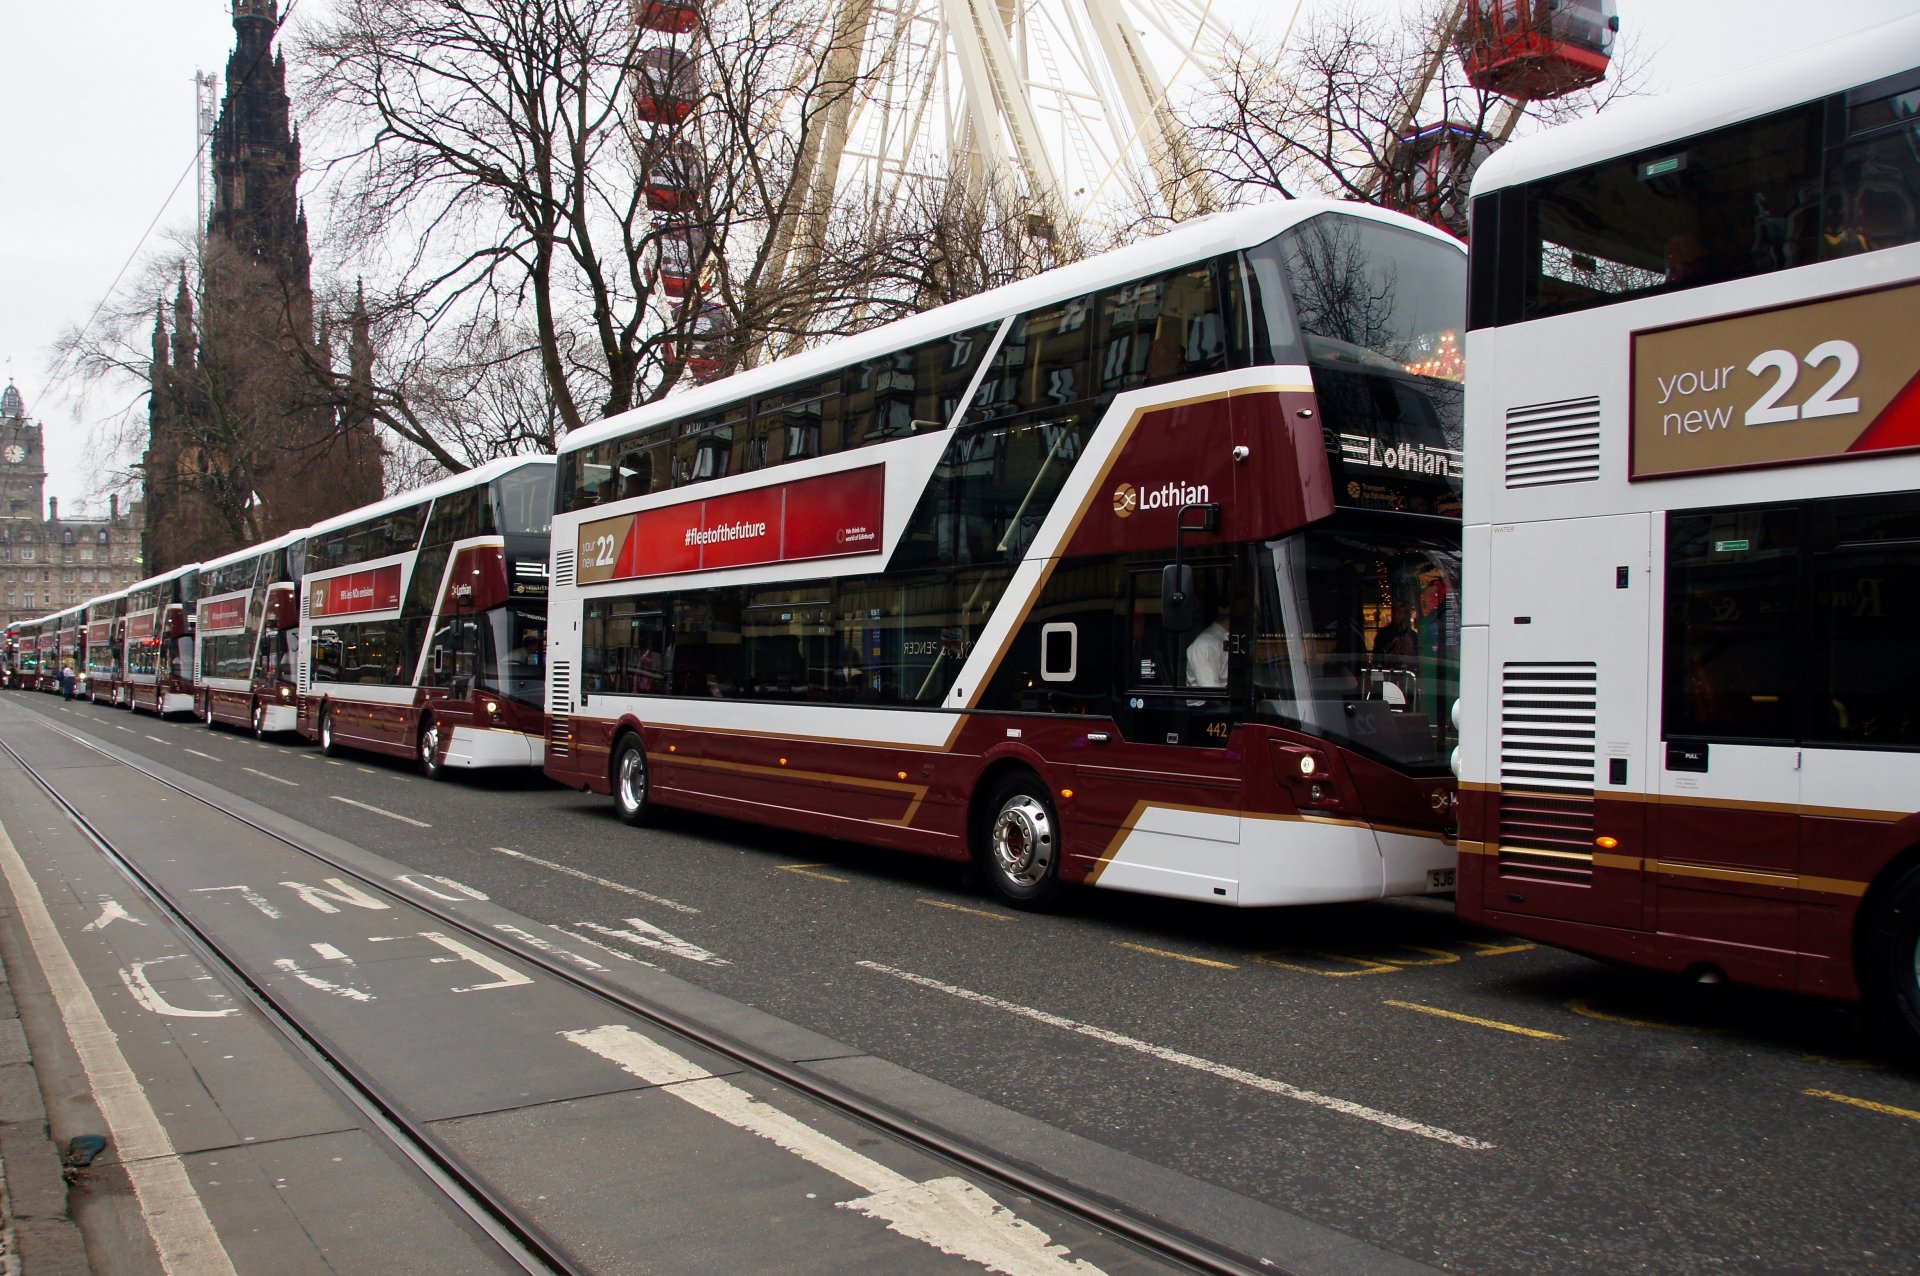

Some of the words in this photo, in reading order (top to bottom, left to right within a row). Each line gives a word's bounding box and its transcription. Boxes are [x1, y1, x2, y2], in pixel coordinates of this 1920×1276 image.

[1657, 363, 1735, 405] your
[1744, 339, 1861, 427] 22
[1663, 404, 1734, 436] new
[1370, 437, 1448, 476] Lothian
[1140, 481, 1209, 510] Lothian
[685, 521, 766, 546] #fleetofthefuture
[582, 540, 596, 555] your
[596, 534, 615, 567] 22
[582, 558, 596, 568] new
[315, 589, 324, 608] 22
[1205, 721, 1228, 738] 442
[1685, 752, 1699, 760] PULL
[1433, 871, 1456, 887] SJ6
[82, 874, 490, 932] ONLY
